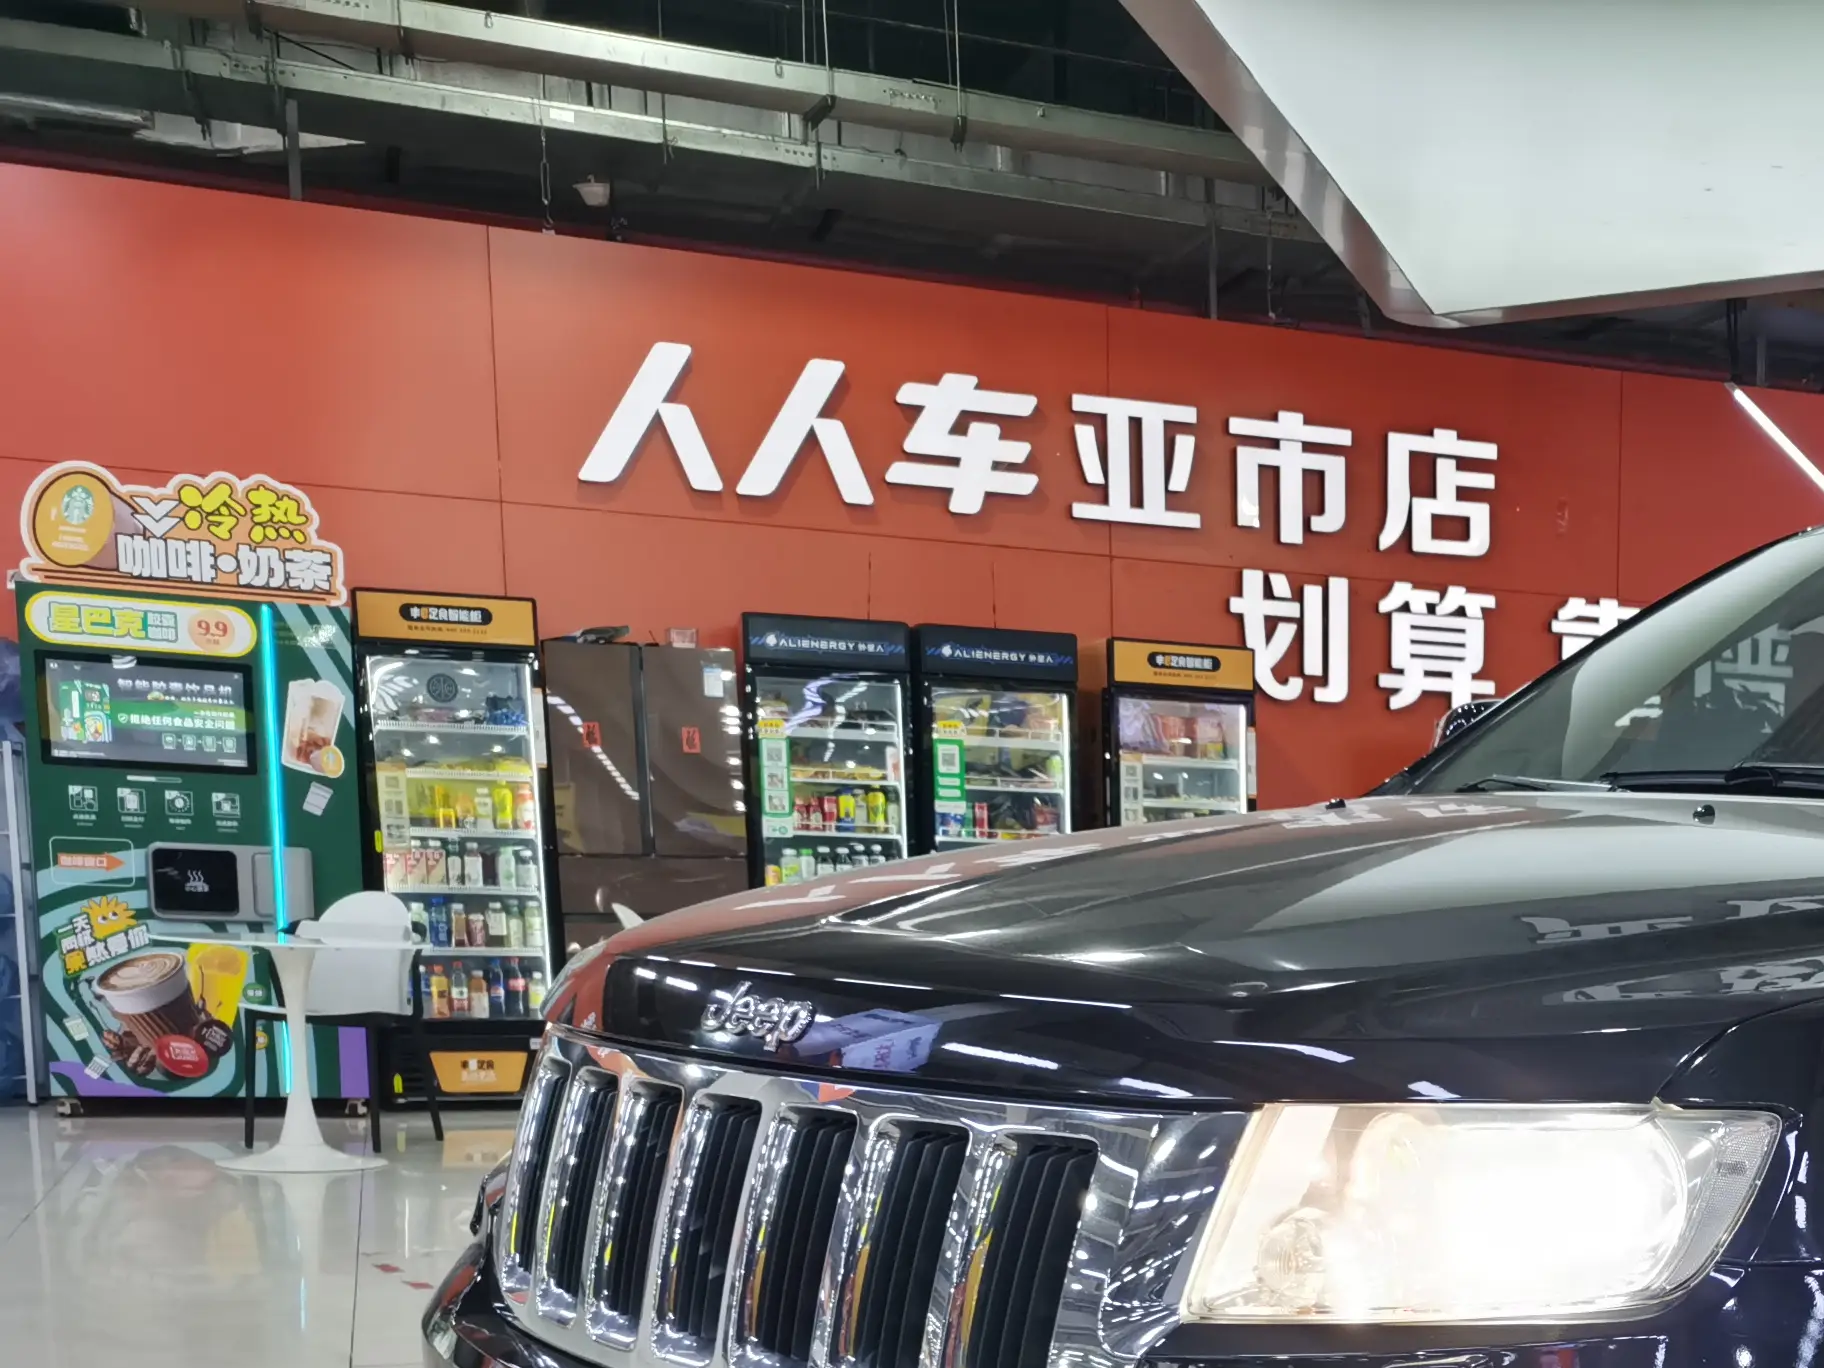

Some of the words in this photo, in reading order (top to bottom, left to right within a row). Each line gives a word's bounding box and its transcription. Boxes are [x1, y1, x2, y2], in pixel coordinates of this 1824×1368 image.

[577, 341, 1498, 557] 人人车亚市店
[179, 482, 307, 543] 冷热
[48, 601, 146, 638] 星巴克
[196, 619, 228, 638] 9.9
[779, 637, 855, 651] ALIENERGY
[1229, 568, 1496, 709] 划算
[954, 649, 1026, 662] ALIENERGY
[701, 980, 816, 1052] Jeep
